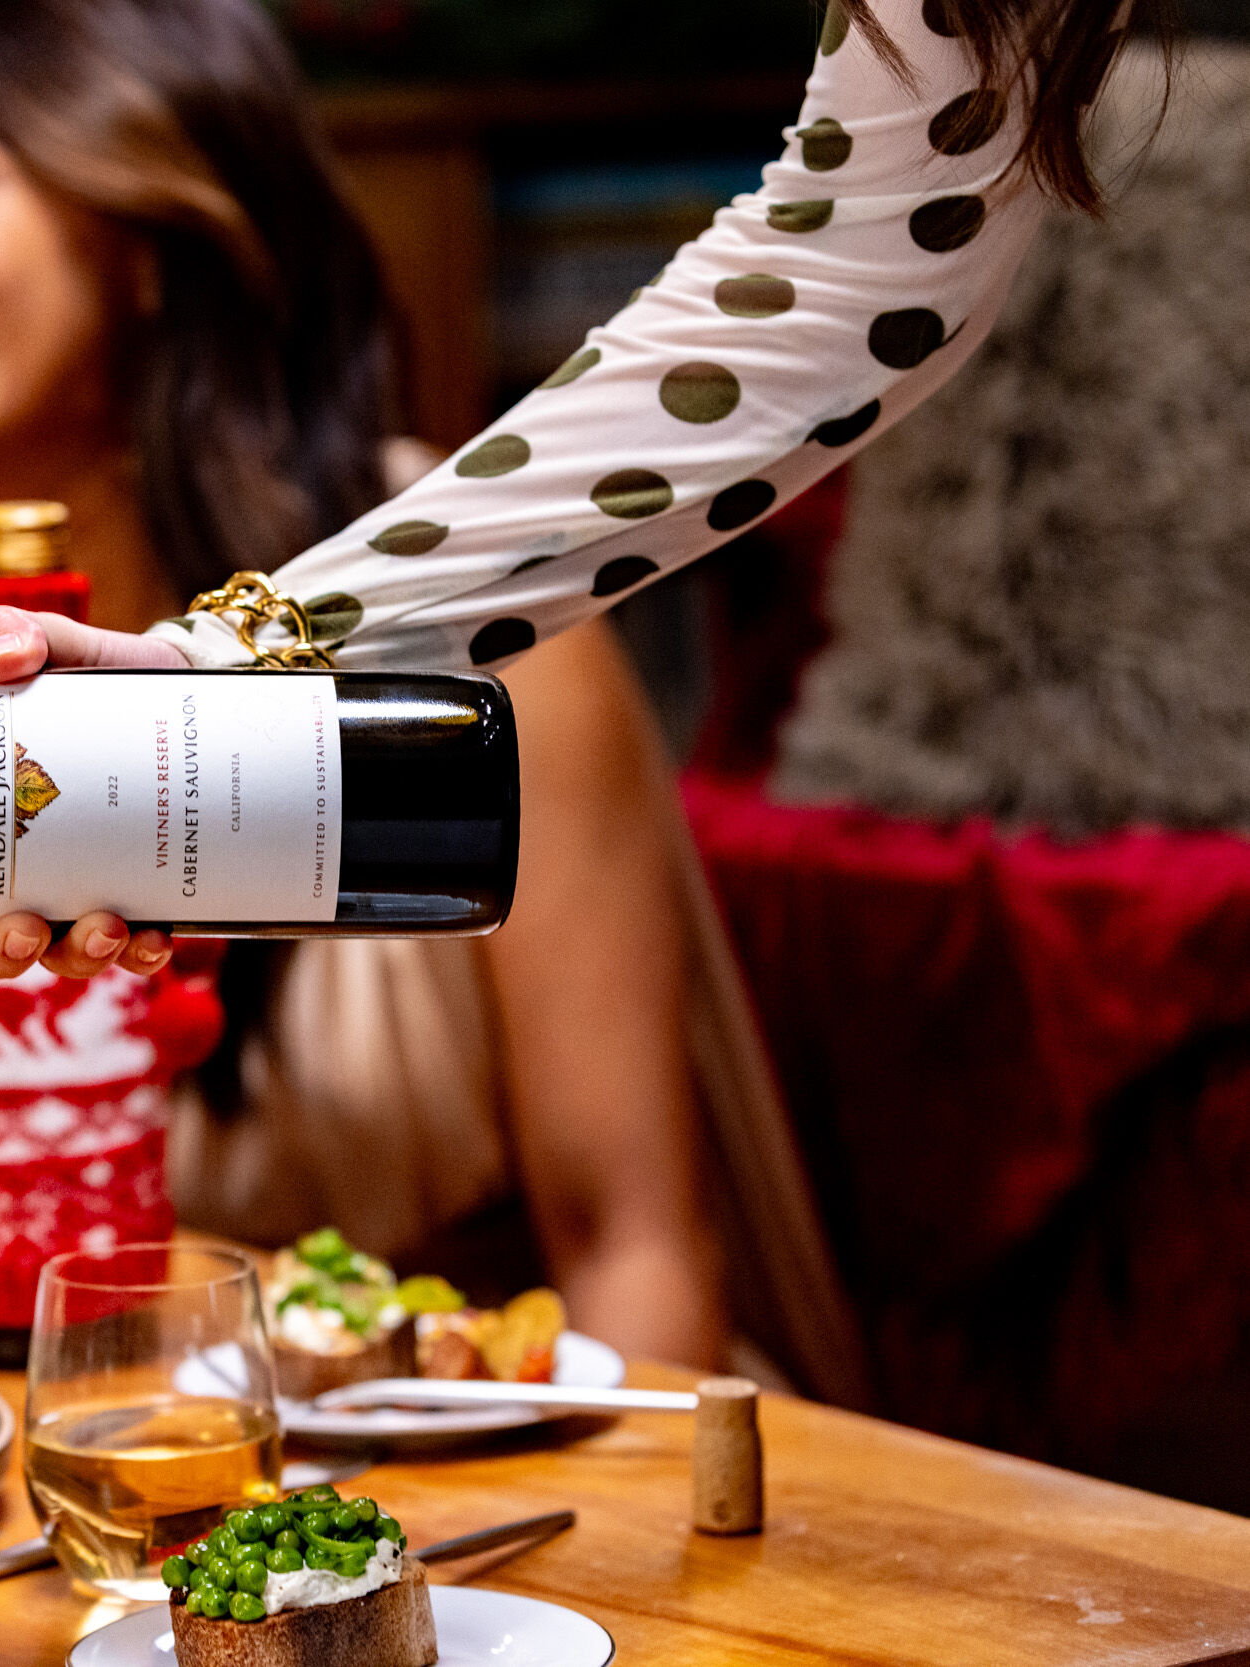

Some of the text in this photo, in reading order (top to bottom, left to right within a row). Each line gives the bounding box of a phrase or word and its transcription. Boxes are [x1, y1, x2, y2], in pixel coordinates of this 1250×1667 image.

[108, 775, 118, 807] 2022
[156, 719, 169, 869] VINTNER'S RESERVE
[182, 693, 199, 897] CABERNET SAUVIGNON
[231, 752, 241, 833] CALIFORNIA
[313, 694, 326, 898] COMMITTED TO SUSTAINABILTY
